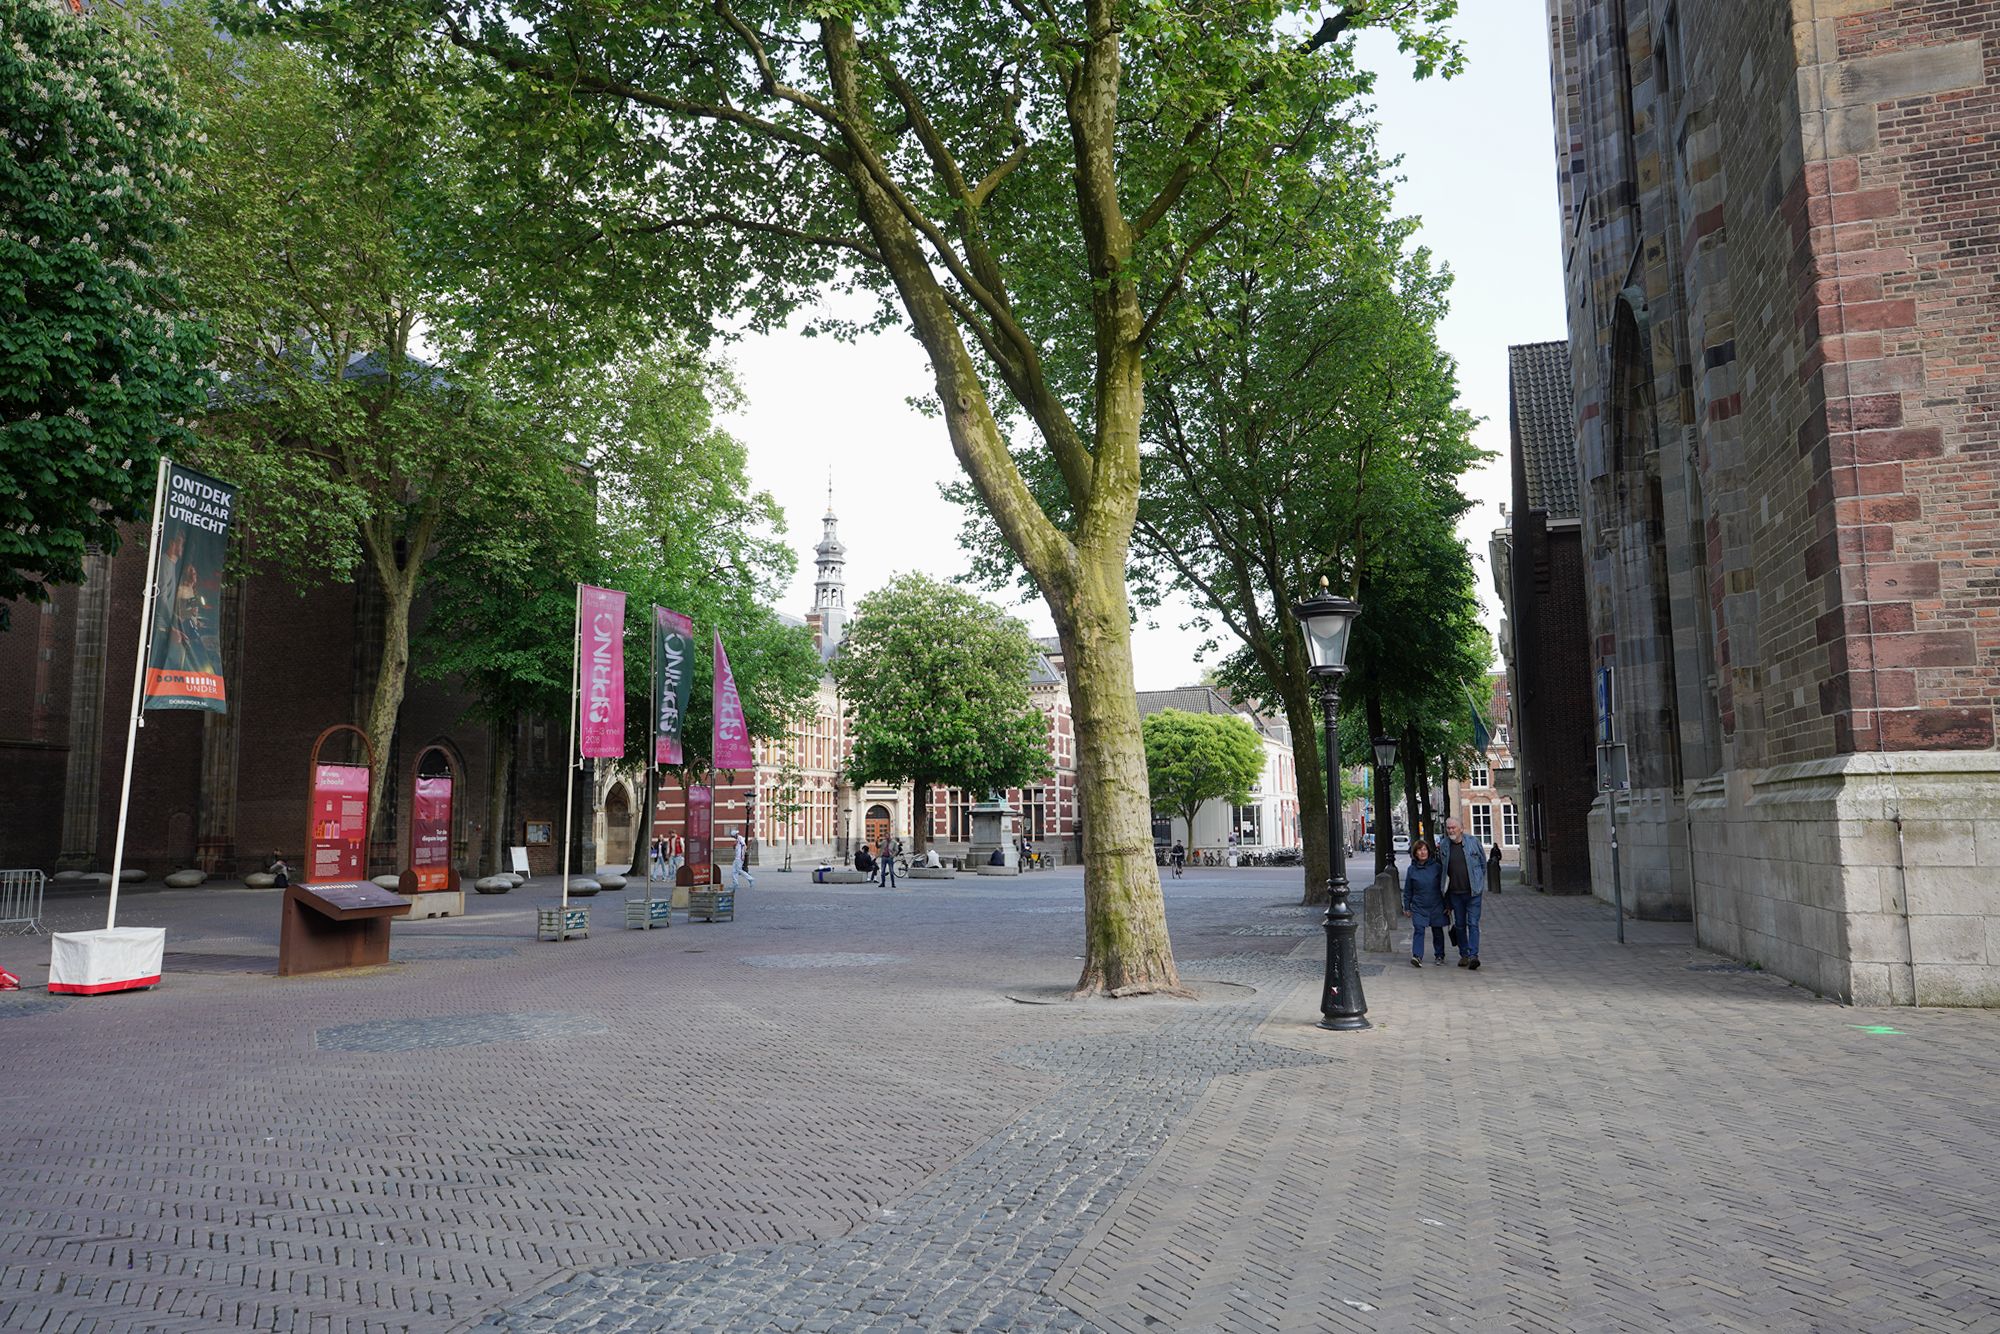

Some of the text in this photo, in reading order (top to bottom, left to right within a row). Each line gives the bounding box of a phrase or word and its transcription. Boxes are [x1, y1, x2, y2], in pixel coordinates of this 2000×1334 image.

[171, 490, 229, 521] 2000 JAAR
[172, 474, 231, 508] ONTDEK
[169, 504, 227, 535] UTRECHT
[186, 684, 218, 695] UNDER
